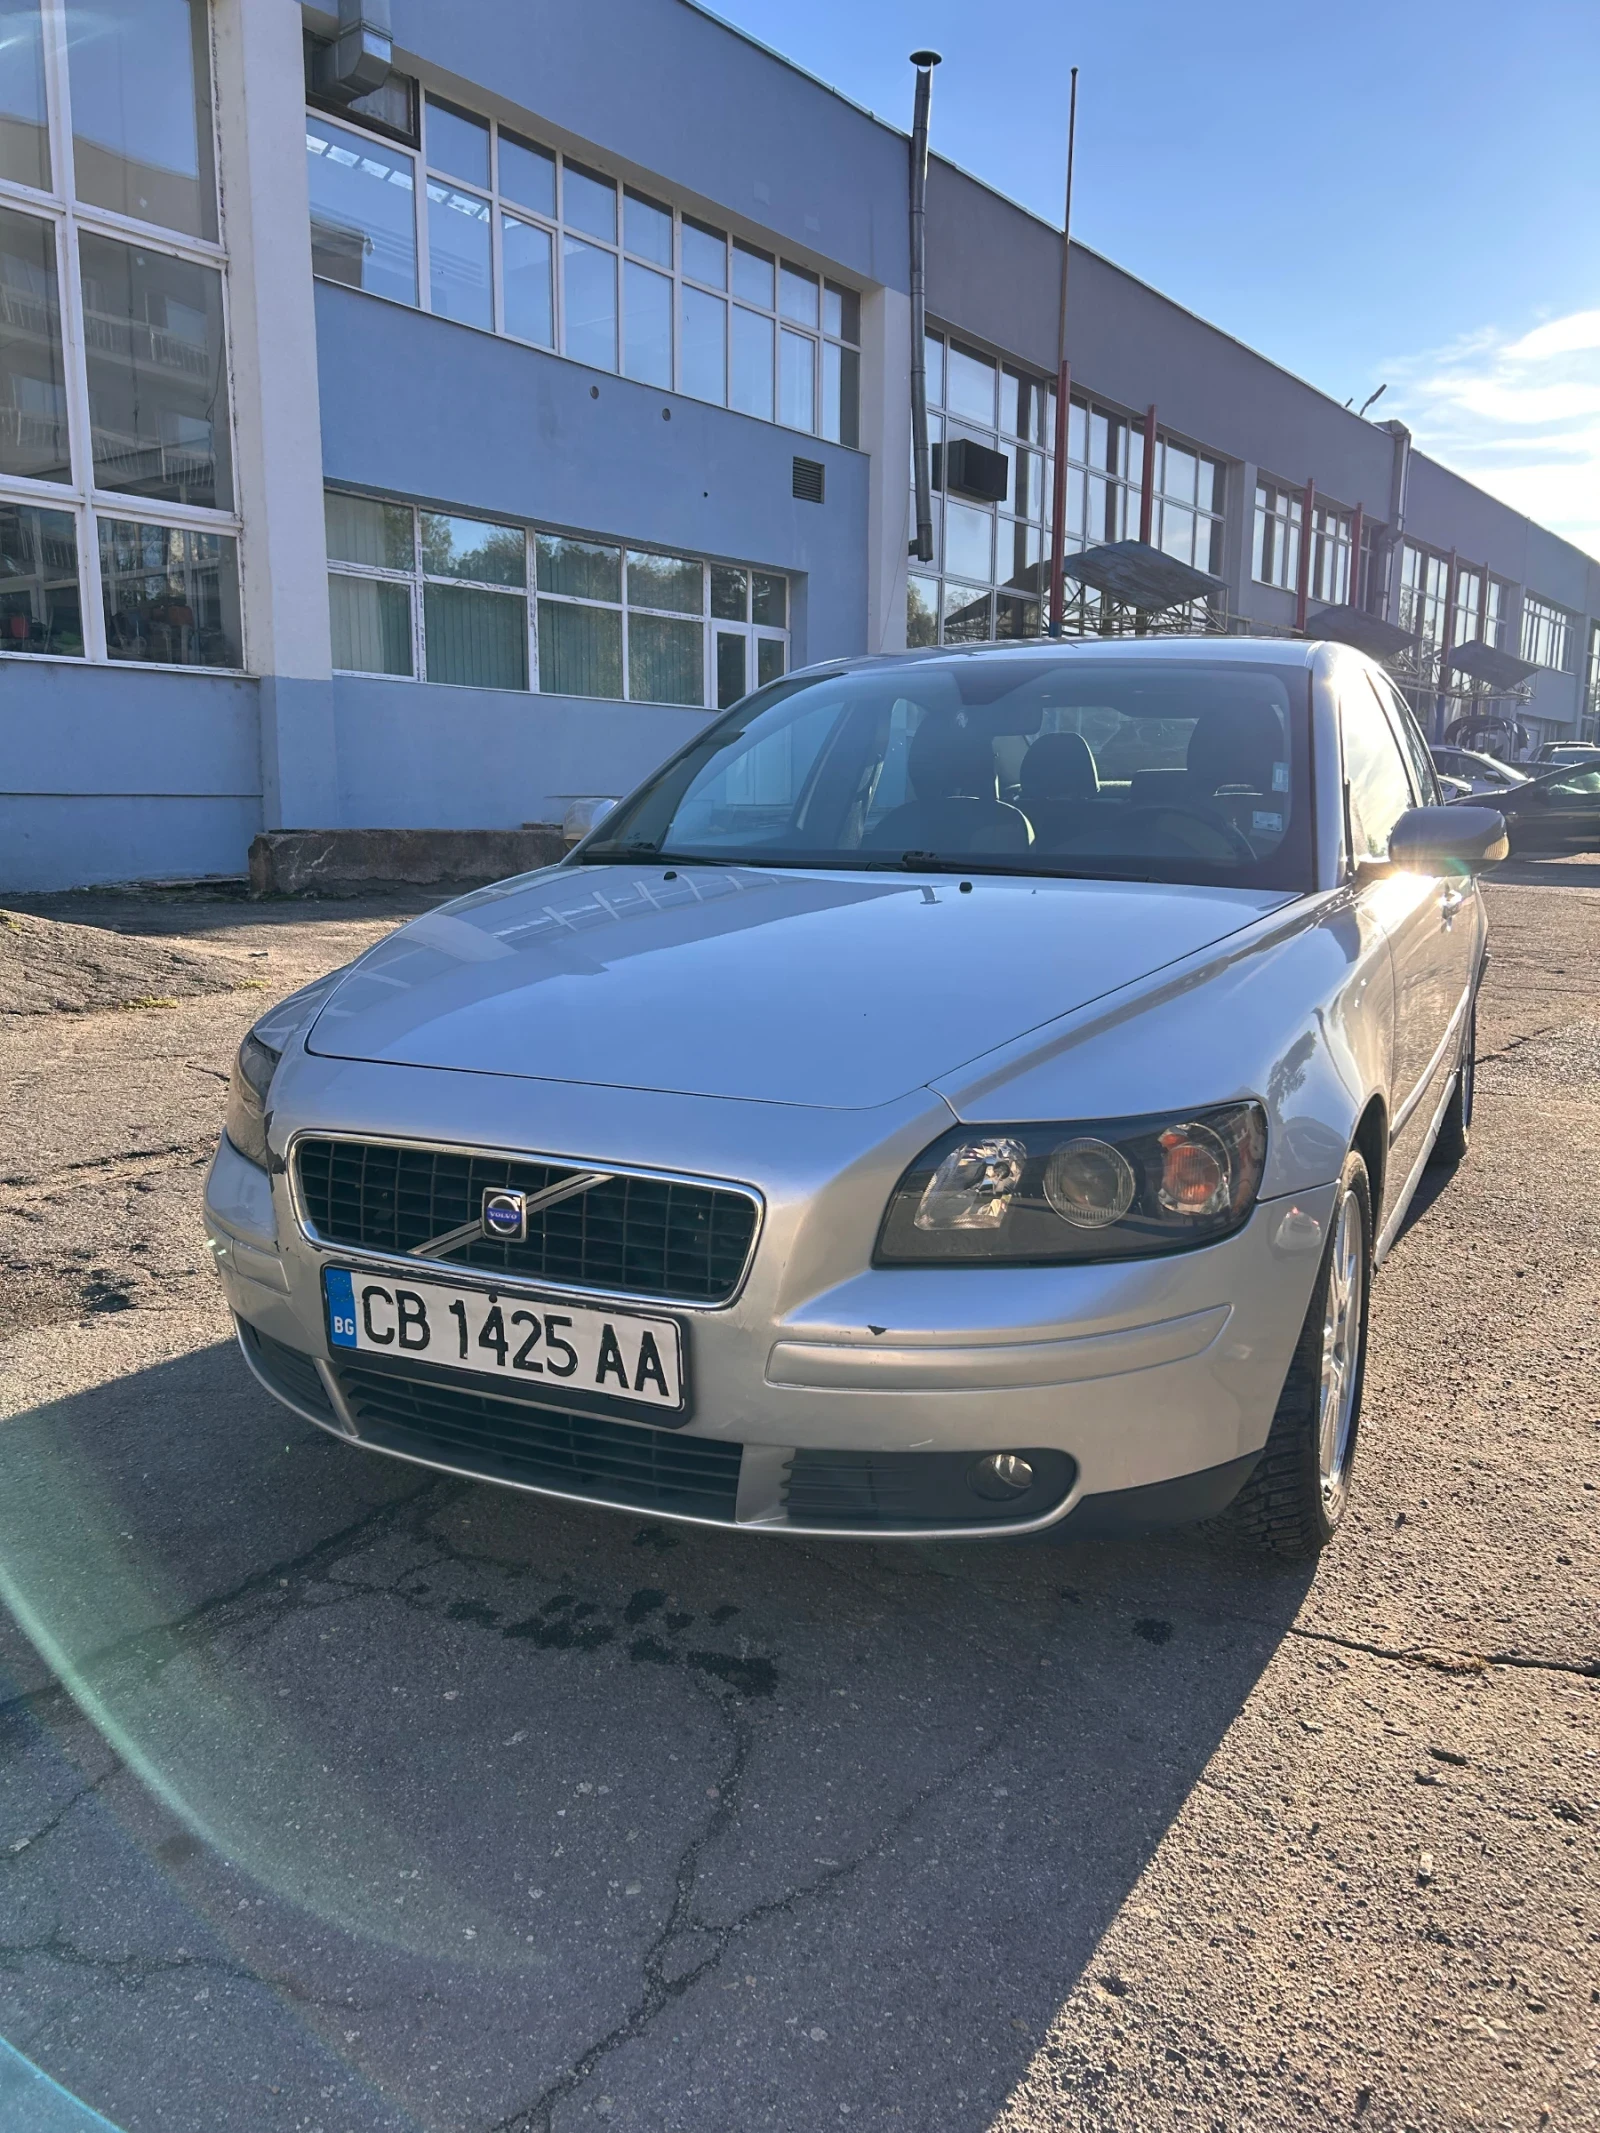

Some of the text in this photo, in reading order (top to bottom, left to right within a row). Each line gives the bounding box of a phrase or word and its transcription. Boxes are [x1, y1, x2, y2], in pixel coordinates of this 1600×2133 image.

[489, 1210, 517, 1220] VOLVO
[333, 1316, 355, 1336] BG
[361, 1285, 670, 1397] CB 1425 AA
